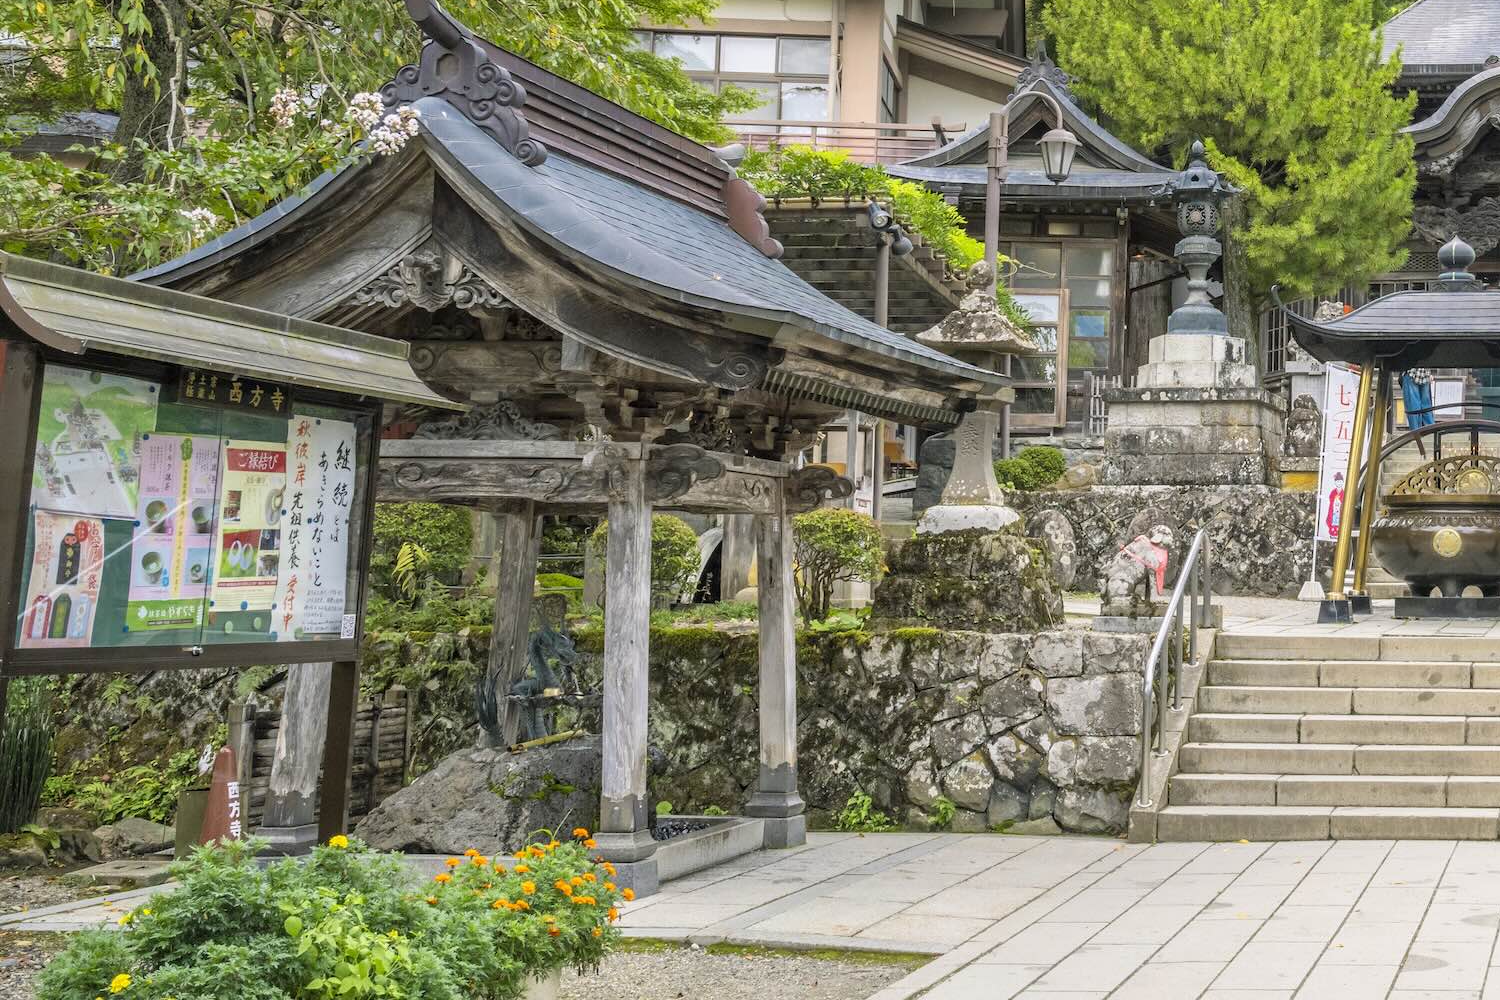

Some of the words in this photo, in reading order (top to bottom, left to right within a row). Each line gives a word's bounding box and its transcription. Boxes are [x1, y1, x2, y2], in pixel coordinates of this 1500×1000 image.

[229, 382, 284, 412] 西方寺
[238, 451, 278, 470] ご縁結び
[330, 440, 352, 543] 継続とは
[312, 450, 329, 587] あきらめないこと
